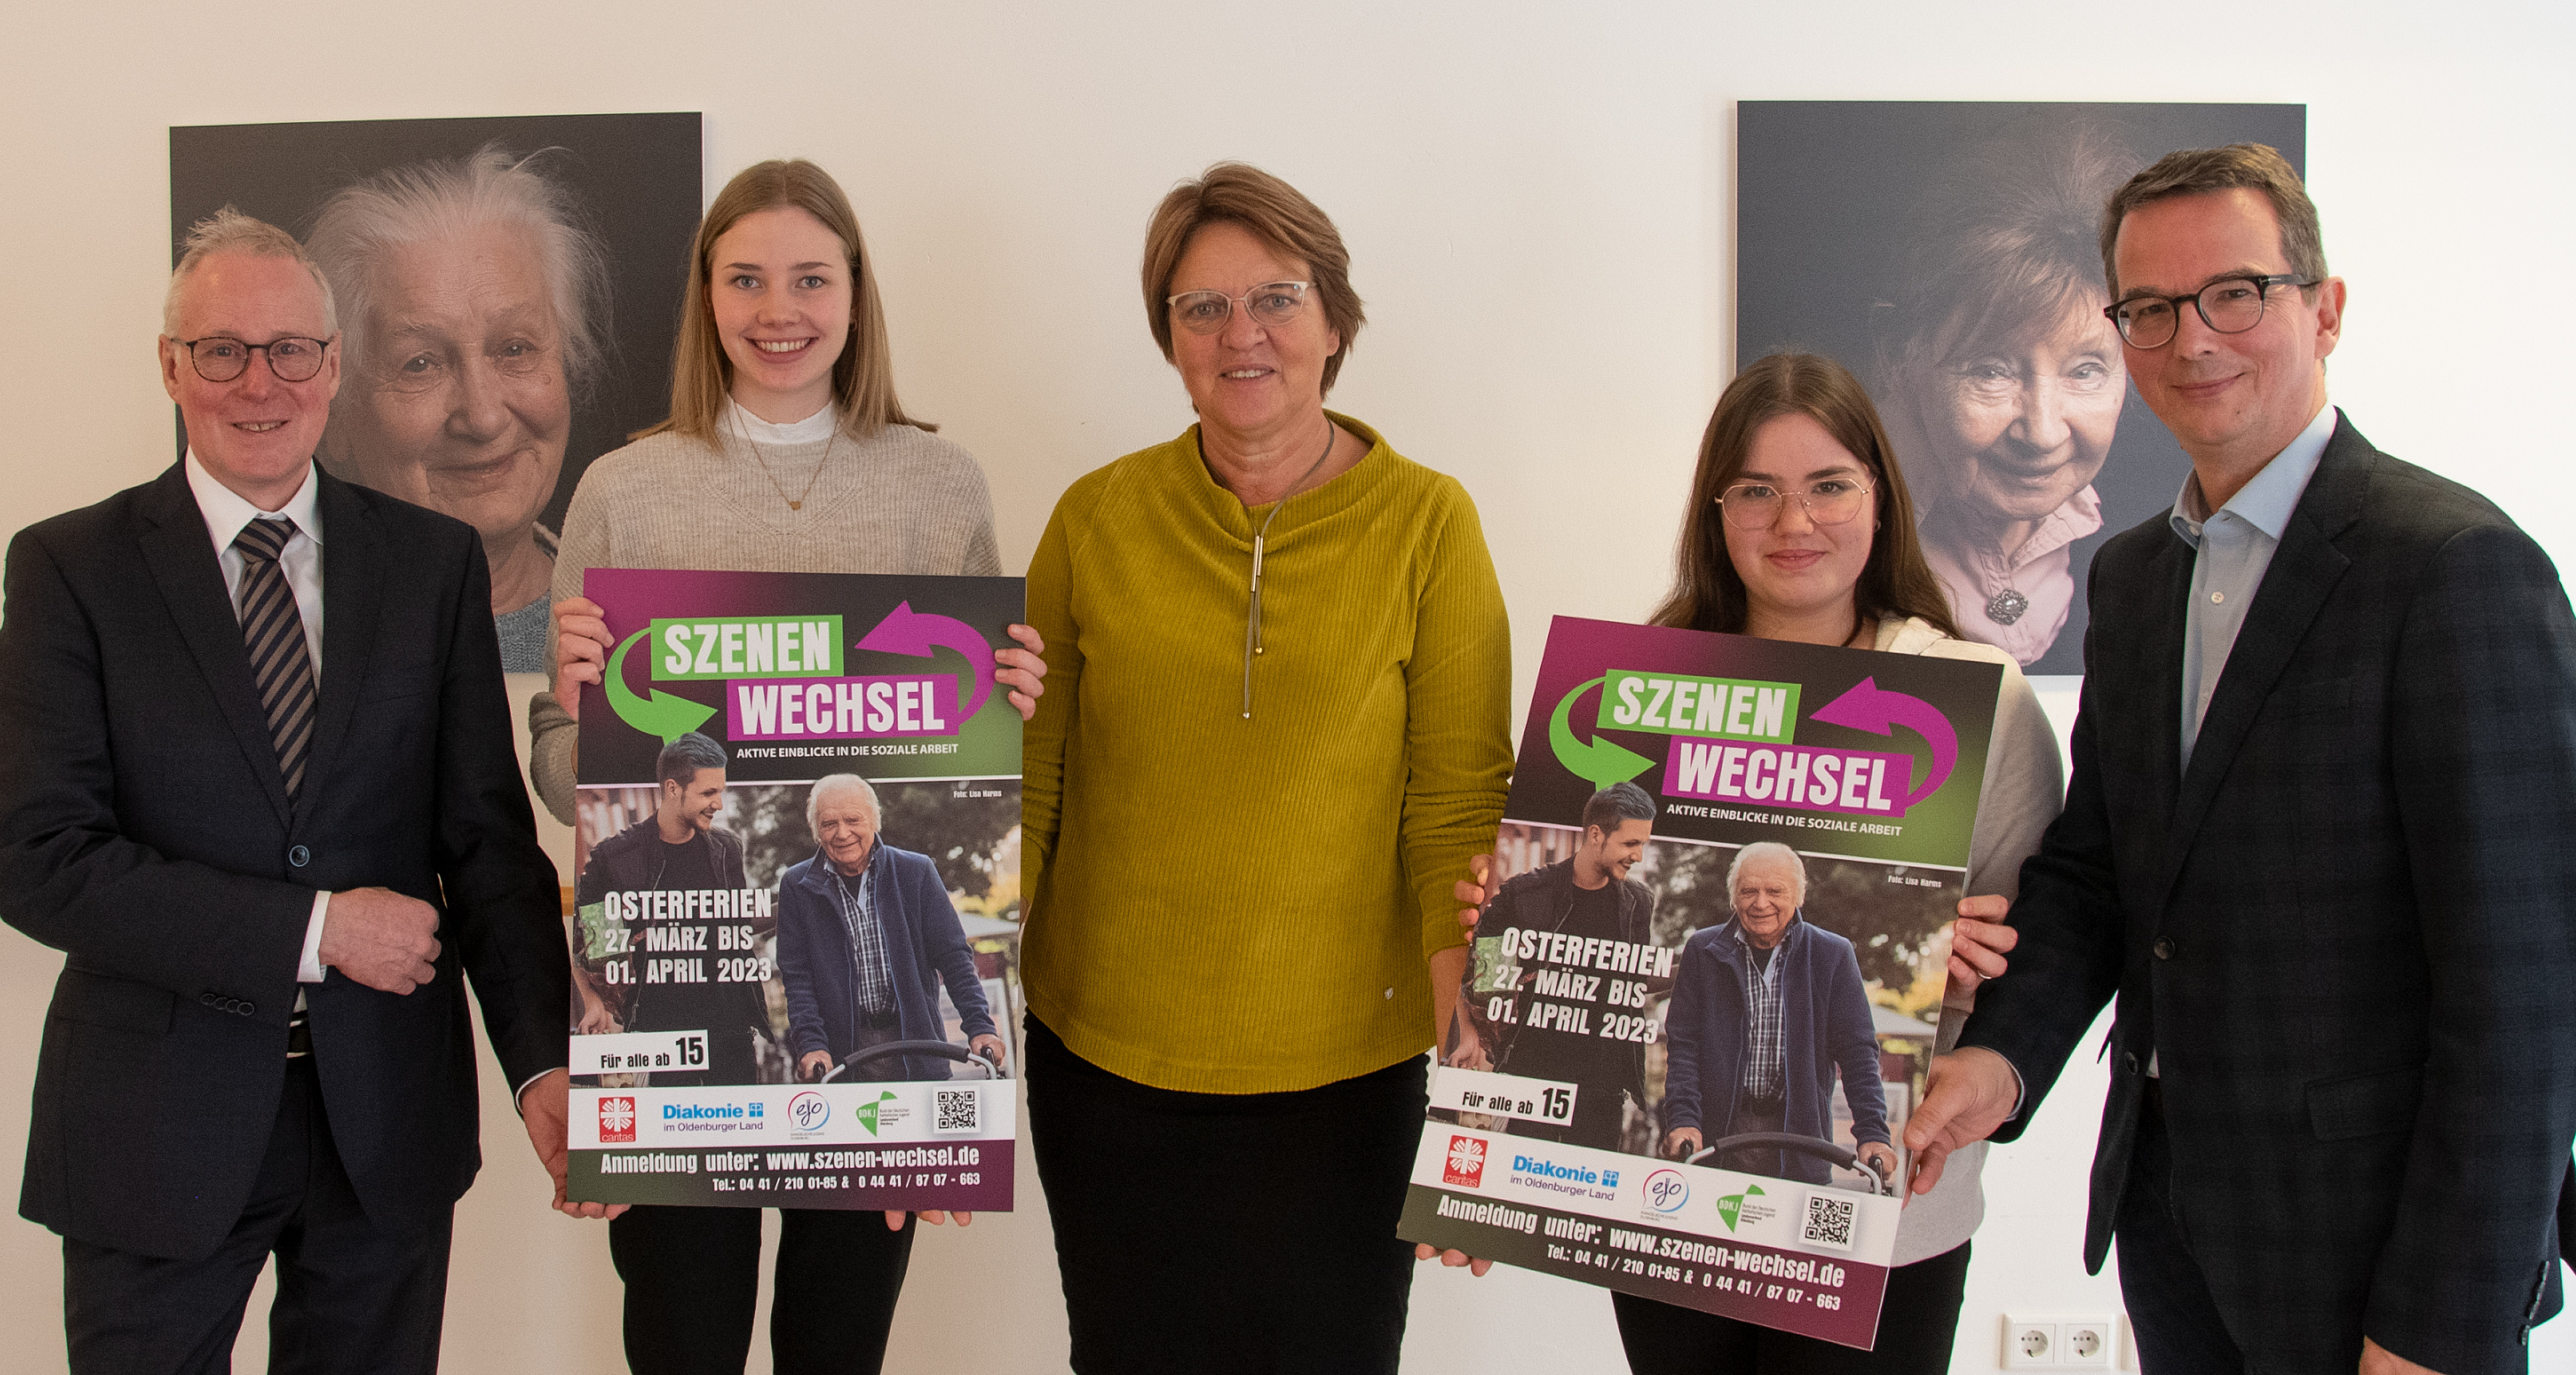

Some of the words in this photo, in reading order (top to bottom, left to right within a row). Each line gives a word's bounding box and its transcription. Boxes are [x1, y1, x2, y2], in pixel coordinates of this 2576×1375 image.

[664, 622, 830, 675] SZENEN
[738, 681, 945, 735] WECHSEL
[1613, 676, 1787, 738] SZENEN
[737, 748, 776, 758] AKTIVE
[778, 746, 834, 758] EINBLICKE
[837, 746, 848, 756] IN
[851, 746, 869, 756] DIE
[871, 745, 917, 755] SOZIALE
[920, 743, 958, 755] ARBEIT
[1677, 743, 1893, 810] WECHSEL
[1667, 804, 1708, 817] AKTIVE
[1710, 808, 1769, 823] EINBLICKE
[1771, 814, 1784, 825] IN
[1785, 816, 1805, 827] DIE
[1807, 818, 1857, 832] SOZIALE
[1859, 823, 1903, 836] ARBEIT
[605, 888, 771, 920] OSTERFERIEN
[605, 928, 636, 952] 27.
[646, 922, 707, 952] MÄRZ
[718, 925, 753, 951] BIS
[1501, 926, 1674, 978] OSTERFERIEN
[606, 960, 636, 985] 01.
[646, 958, 707, 984] APRIL
[717, 957, 771, 983] 2023
[1492, 964, 1524, 991] 27.
[1534, 966, 1601, 1002] MÄRZ
[1607, 978, 1648, 1009] BIS
[1487, 996, 1517, 1024] 01.
[1526, 1001, 1590, 1035] APRIL
[1599, 1012, 1660, 1044] 2023
[601, 1054, 621, 1068] Für
[627, 1053, 649, 1067] alle
[655, 1052, 670, 1067] ab
[676, 1037, 704, 1065] 15
[663, 1103, 744, 1119] Diakonie
[796, 1099, 823, 1126] ejo
[1462, 1092, 1484, 1107] Für
[1489, 1096, 1512, 1112] alle
[1517, 1100, 1533, 1114] ab
[1542, 1087, 1570, 1119] 15
[601, 1133, 634, 1142] caritas
[664, 1122, 675, 1132] im
[678, 1122, 737, 1132] Oldenburger
[740, 1121, 763, 1130] Land
[600, 1153, 698, 1174] Anmeldung
[705, 1152, 759, 1171] unter:
[766, 1146, 980, 1170] www.szenen-wechsel.de
[1513, 1155, 1597, 1184] Diakonie
[713, 1178, 735, 1192] Tel.:
[740, 1178, 753, 1190] 04
[758, 1178, 770, 1190] 41
[784, 1177, 804, 1190] 210
[841, 1175, 850, 1189] &
[858, 1175, 866, 1189] 0
[870, 1174, 885, 1188] 44
[889, 1174, 902, 1188] 41
[915, 1174, 930, 1187] 87
[934, 1173, 947, 1187] 07
[959, 1172, 980, 1185] 663
[1445, 1174, 1478, 1187] caritas
[1510, 1174, 1523, 1185] im
[1525, 1177, 1587, 1197] Oldenburger
[1589, 1190, 1615, 1202] Land
[1652, 1177, 1682, 1206] ejo
[1718, 1199, 1739, 1212] BDKJ
[1437, 1194, 1538, 1235] Anmeldung
[1544, 1216, 1602, 1245] unter:
[1609, 1227, 1845, 1288] www.szenen-wechsel.de
[1547, 1244, 1572, 1261] Tel.:
[1575, 1249, 1590, 1265] 04
[1595, 1253, 1608, 1269] 41
[1622, 1258, 1644, 1275] 210
[1684, 1269, 1694, 1284] &
[1703, 1272, 1712, 1288] 0
[1716, 1275, 1733, 1291] 44
[1737, 1279, 1752, 1294] 41
[1767, 1285, 1783, 1300] 87
[1786, 1288, 1804, 1303] 07
[1817, 1294, 1841, 1311] 663
